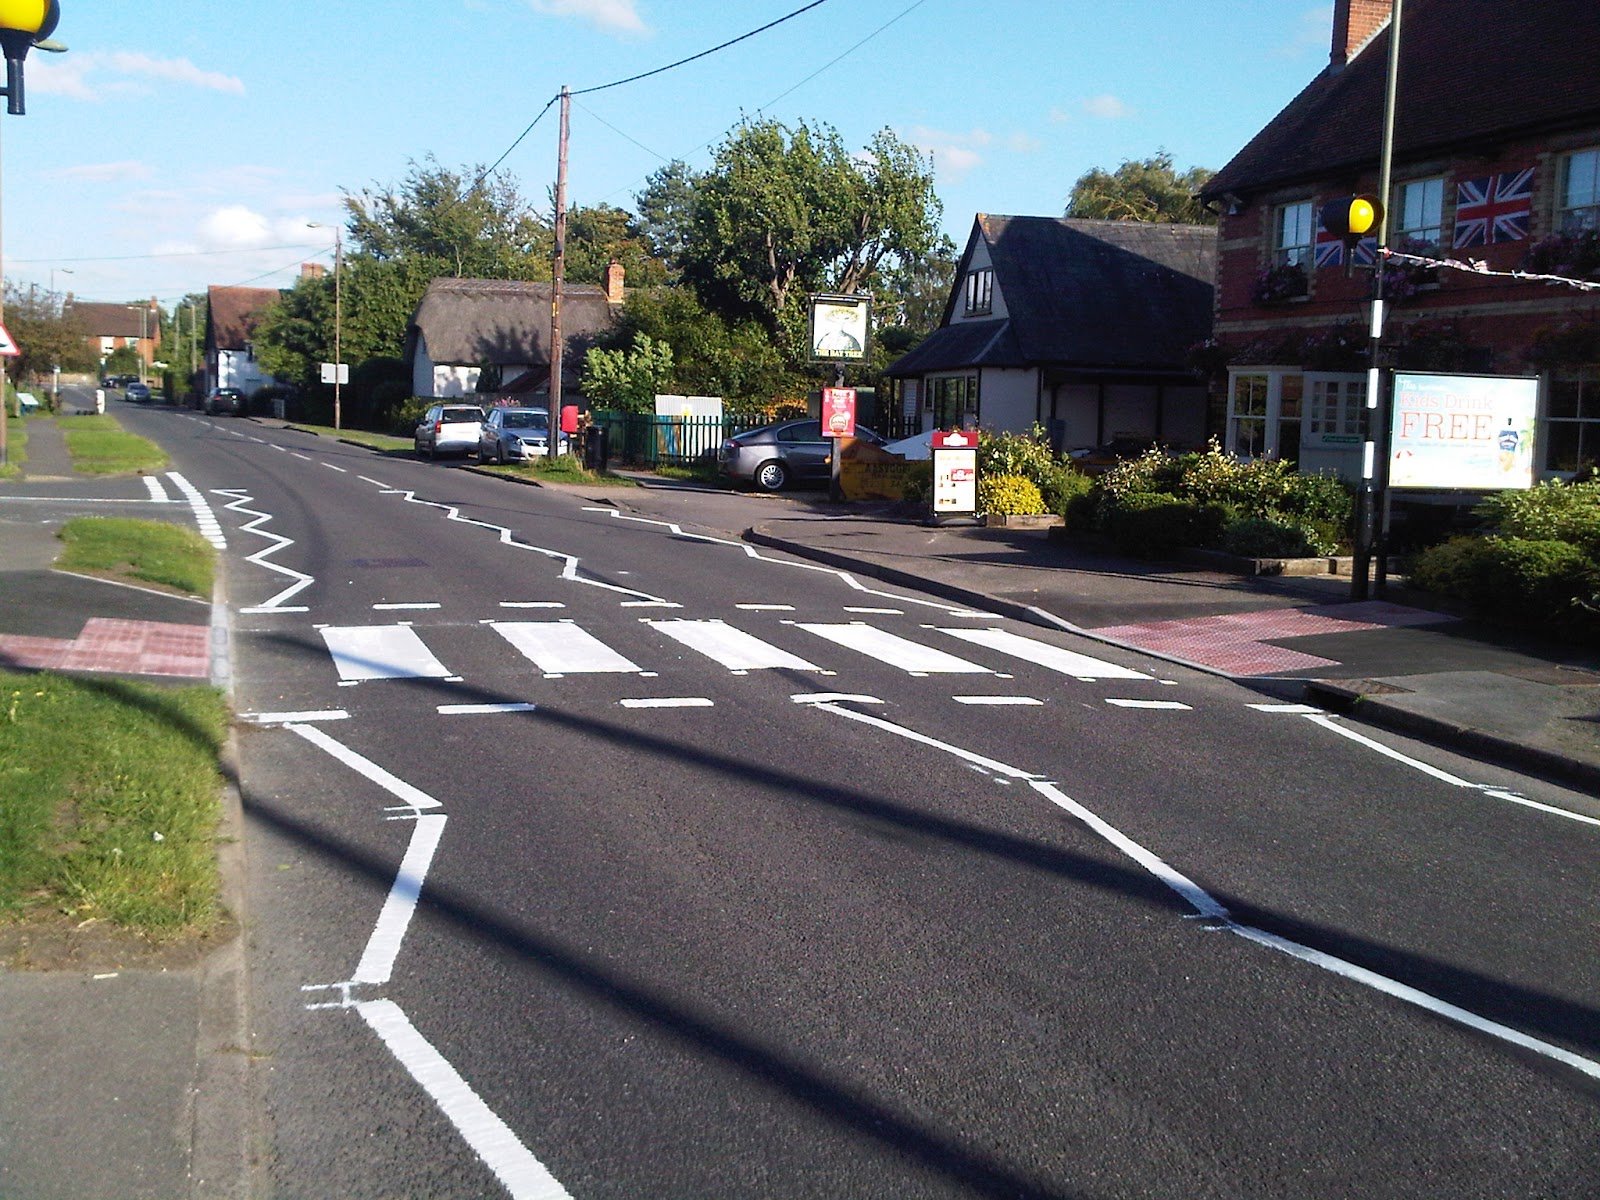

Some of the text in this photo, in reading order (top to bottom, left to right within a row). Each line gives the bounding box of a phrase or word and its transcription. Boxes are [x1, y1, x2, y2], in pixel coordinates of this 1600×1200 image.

[1399, 391, 1494, 410] Kids Drink
[1399, 411, 1493, 441] FREE
